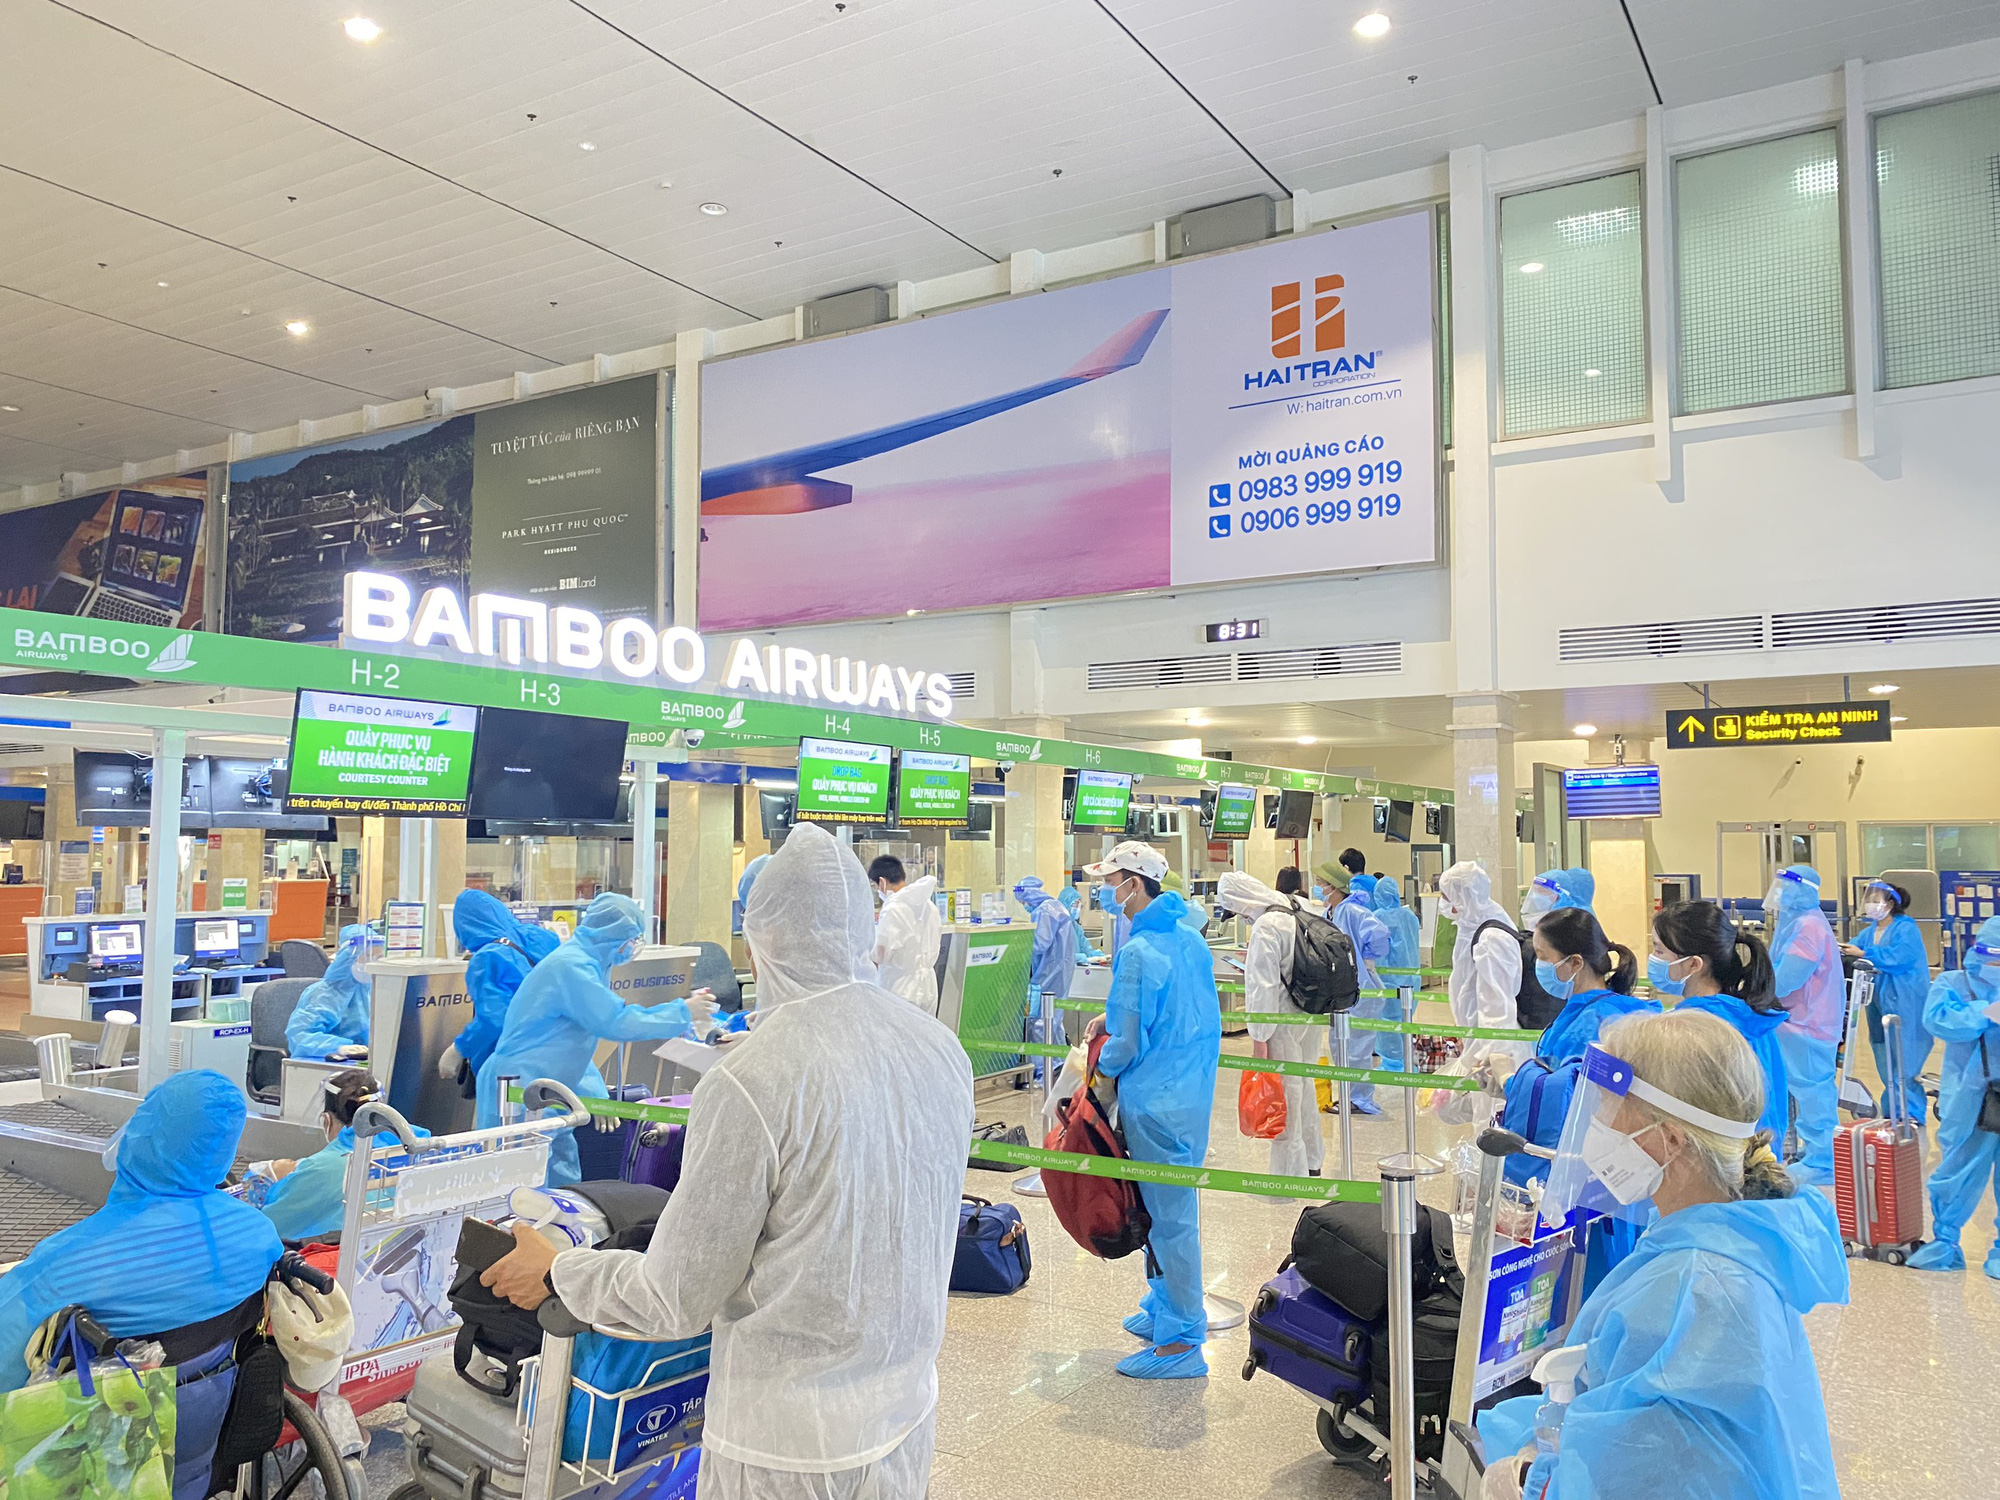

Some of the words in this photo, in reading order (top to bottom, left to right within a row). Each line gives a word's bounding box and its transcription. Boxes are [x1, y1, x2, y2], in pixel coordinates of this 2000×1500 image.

[1313, 372, 1376, 388] CORPORATION
[1287, 403, 1304, 415] W:
[1306, 388, 1402, 413] haitran.com.vn
[490, 436, 528, 455] TUYỆT
[529, 431, 553, 447] TÁC
[554, 430, 572, 443] của
[575, 421, 612, 440] RIÊNG
[615, 416, 640, 433] BẠN
[1238, 451, 1271, 469] MỜI
[1275, 442, 1340, 465] QUẢNG
[1344, 434, 1384, 454] CÁO
[1238, 474, 1298, 502] 0983
[1304, 466, 1351, 493] 999
[1358, 459, 1403, 487] 919
[1240, 505, 1300, 534] 0906
[1305, 499, 1351, 526] 999
[1357, 493, 1402, 520] 919
[502, 528, 527, 539] PARK
[531, 522, 563, 535] HYATT
[568, 519, 589, 530] PHU
[1218, 622, 1259, 641] 8:31
[15, 628, 150, 658] BAMBOO
[344, 571, 705, 683] BAMBOO
[721, 638, 953, 718] AIRWAYS
[16, 650, 68, 661] AIRWAYS
[351, 658, 400, 689] H-2
[520, 679, 560, 705] H-3
[328, 703, 381, 716] BAMBOO
[385, 708, 434, 721] AIRWAYS
[661, 701, 724, 719] BAMBOO
[661, 715, 686, 723] AIRWAYS
[825, 714, 851, 735] H-4
[1745, 710, 1781, 727] KIỂM
[1783, 712, 1813, 725] TRA
[1816, 711, 1838, 724] AN
[1841, 710, 1879, 722] NINH
[345, 725, 380, 748] QUẦY
[380, 732, 414, 753] PHỤC
[415, 735, 432, 755] VỤ
[626, 732, 666, 744] MBOO
[919, 727, 941, 746] H-5
[1745, 727, 1798, 741] Security
[1800, 725, 1842, 738] Check
[816, 746, 843, 755] BAMBOO
[844, 749, 870, 757] AIRWAYS
[996, 742, 1030, 754] BAMBOO
[318, 746, 355, 768] HÀNH
[356, 749, 398, 770] KHÁCH
[399, 751, 424, 775] ĐẶC
[425, 753, 451, 776] BIỆT
[1085, 749, 1101, 764] H-6
[338, 772, 387, 784] COURTESY
[387, 774, 428, 786] COUNTER
[1220, 767, 1232, 778] H-7
[290, 798, 310, 808] trên
[311, 797, 343, 809] chuyến
[345, 800, 360, 811] bay
[392, 800, 417, 811] Thành
[418, 800, 435, 813] phố
[436, 801, 447, 812] Hồ
[448, 802, 461, 812] Chí
[633, 974, 685, 988] BUSINESS
[1224, 1059, 1249, 1067] BAMBOO
[1250, 1062, 1276, 1070] AIRWAYS
[1305, 1068, 1332, 1076] BAMBOO
[1334, 1071, 1361, 1079] AIRWAYS
[1394, 1076, 1422, 1084] BAMBOO
[1007, 1151, 1041, 1162] BAMBOO
[1043, 1156, 1078, 1167] AIRWAYS
[1120, 1166, 1157, 1177] BAMBOO
[1159, 1171, 1196, 1181] AIRWAYS
[1242, 1179, 1282, 1190] BAMBOO
[1284, 1184, 1325, 1194] AIRWAYS
[1533, 1251, 1545, 1263] CHO
[1537, 1278, 1550, 1292] TOA
[1510, 1288, 1525, 1304] TOA
[637, 1431, 669, 1448] VINATEX
